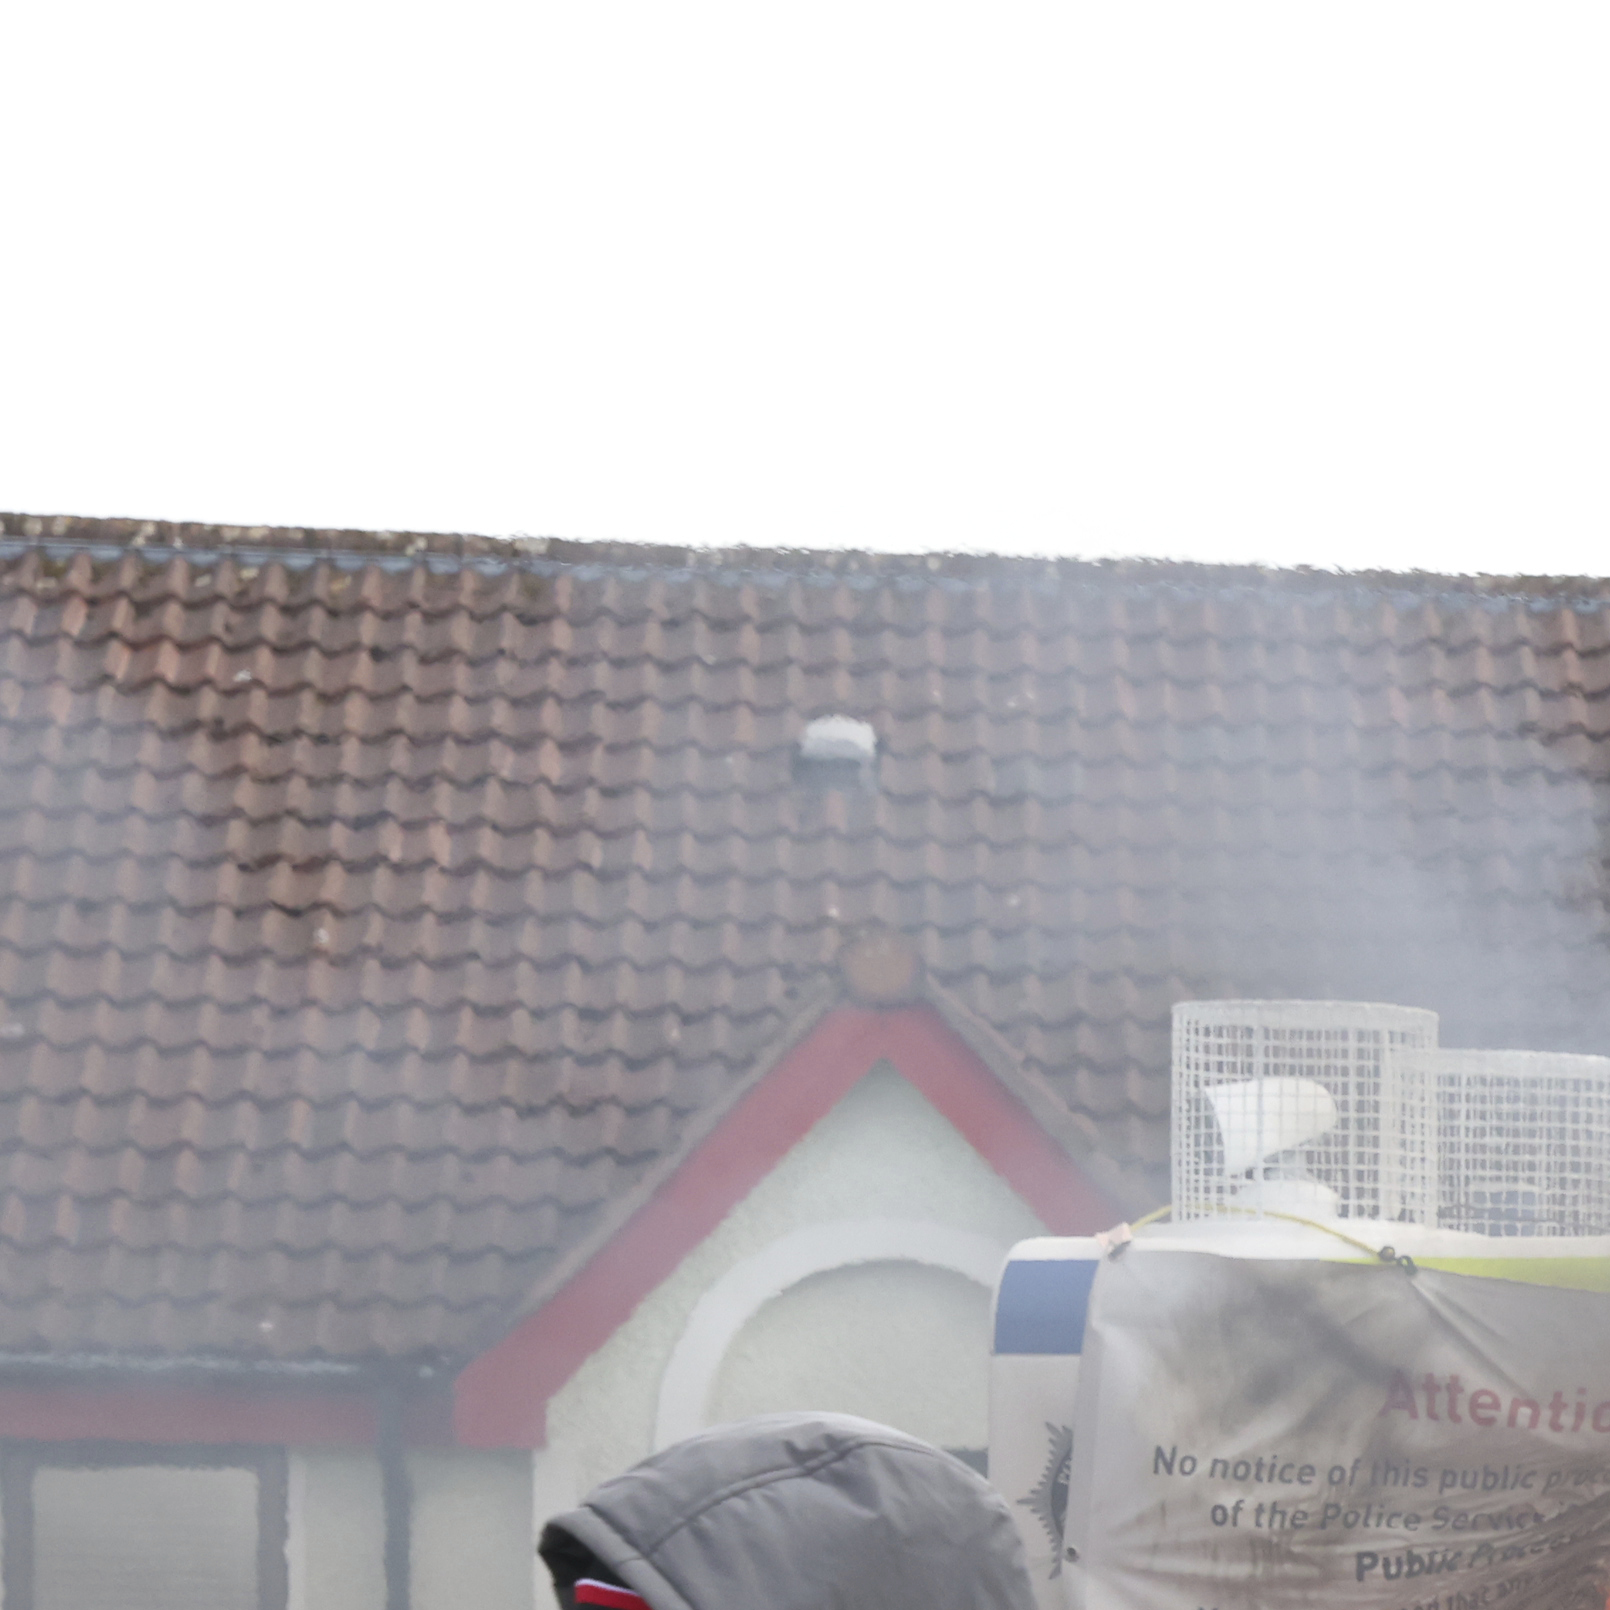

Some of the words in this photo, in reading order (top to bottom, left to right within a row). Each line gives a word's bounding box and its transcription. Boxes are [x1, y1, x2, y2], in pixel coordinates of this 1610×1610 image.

[1153, 1445, 1197, 1476] No
[1209, 1455, 1316, 1485] notice
[1328, 1458, 1361, 1486] of
[1370, 1459, 1428, 1488] this
[1438, 1464, 1537, 1495] public
[1212, 1499, 1245, 1527] of
[1255, 1501, 1308, 1529] the
[1319, 1503, 1421, 1532] Police
